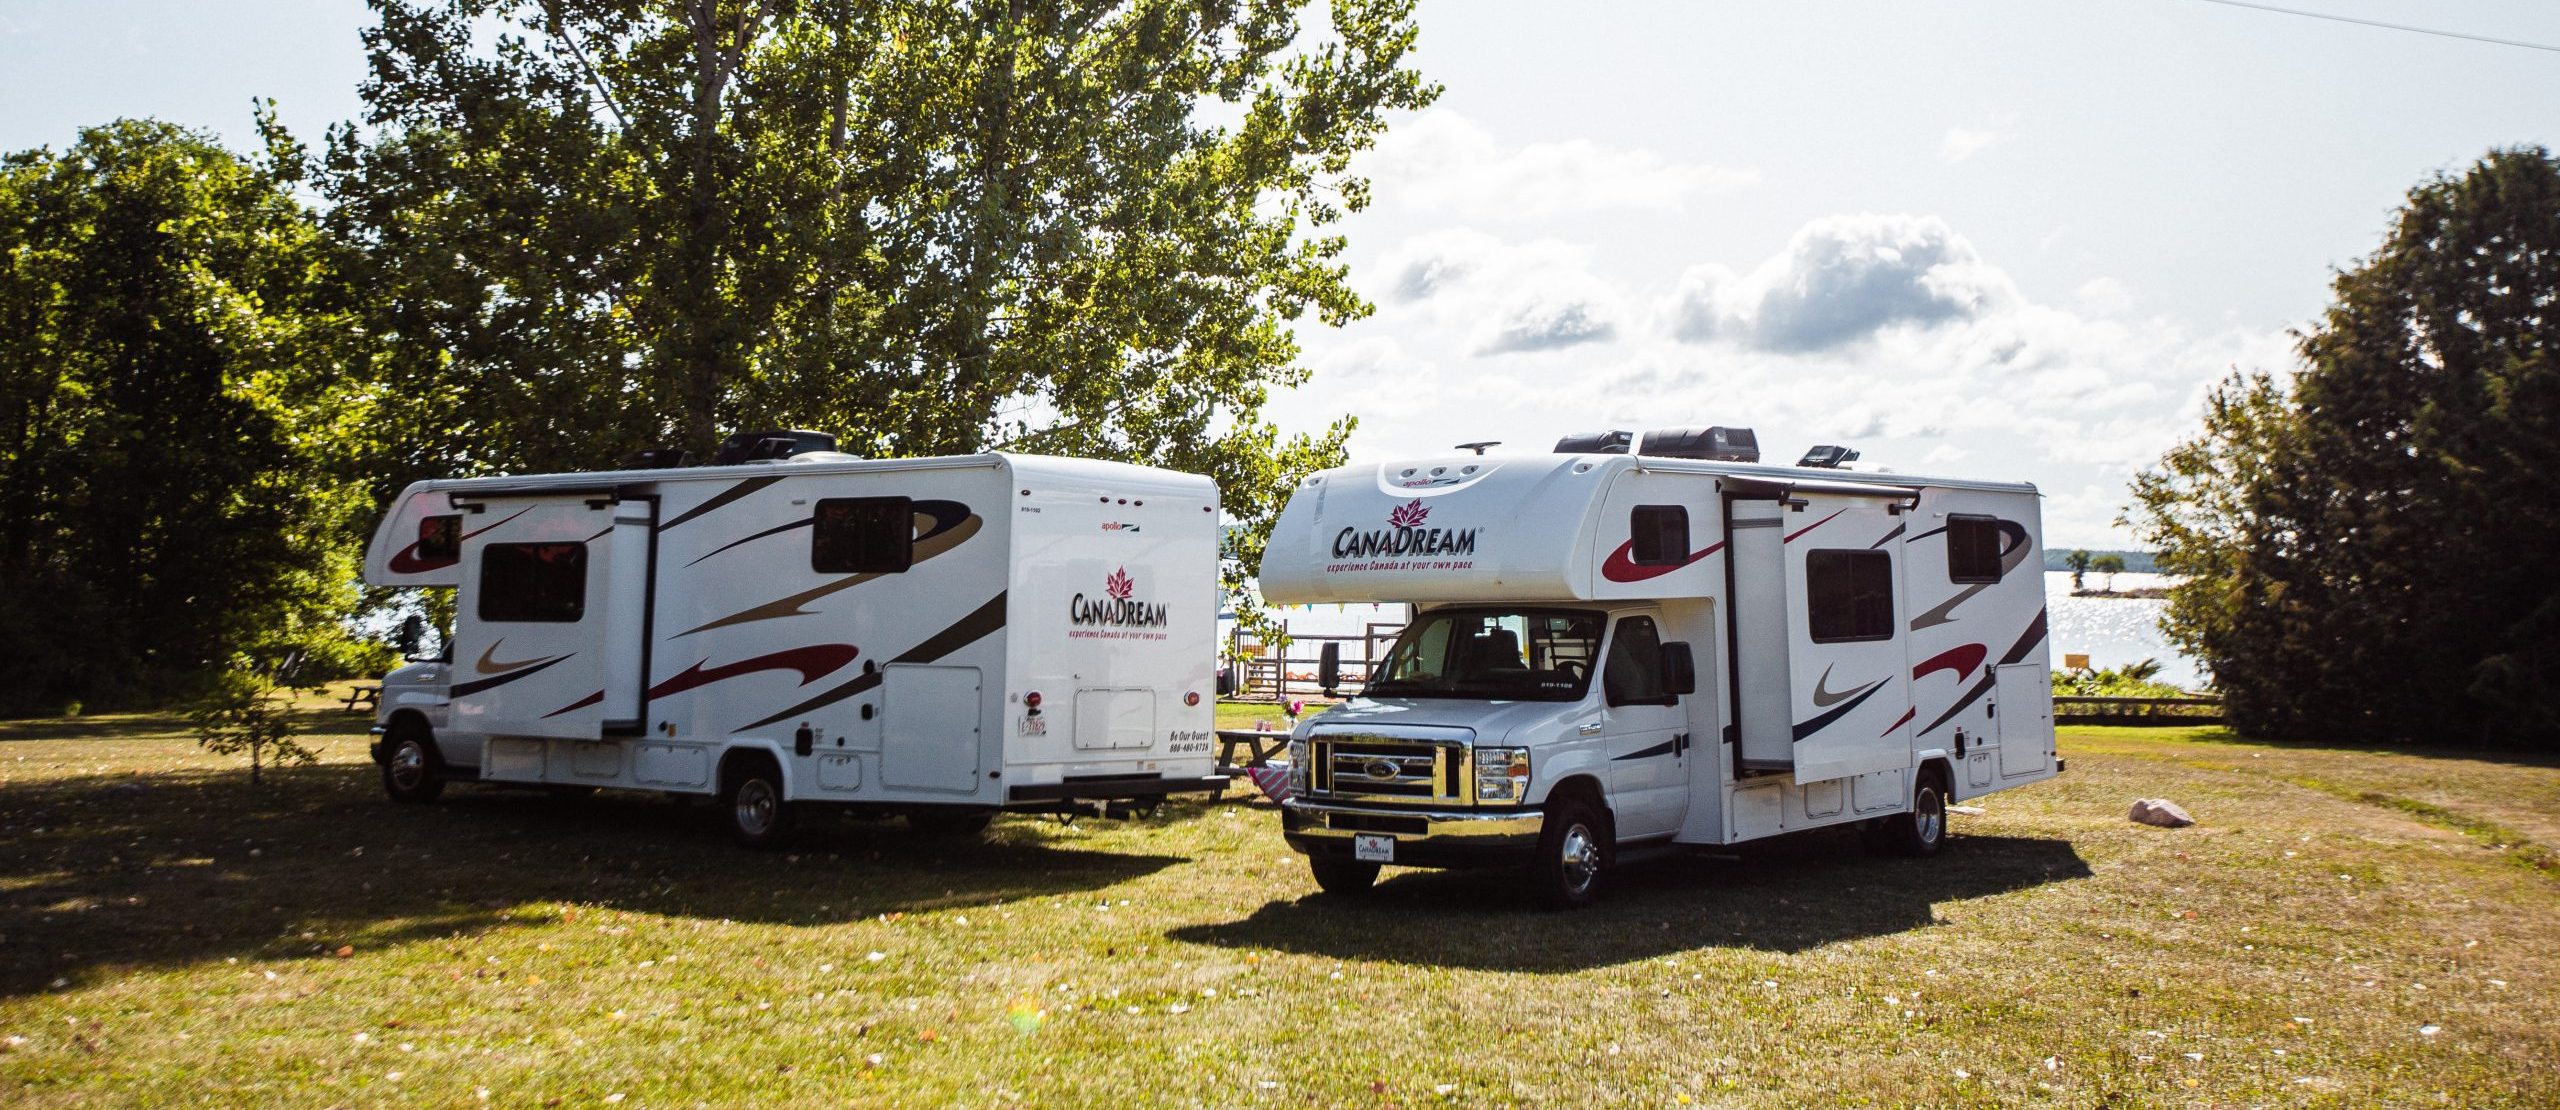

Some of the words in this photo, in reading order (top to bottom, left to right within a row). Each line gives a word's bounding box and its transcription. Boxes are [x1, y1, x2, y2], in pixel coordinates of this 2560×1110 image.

[1402, 478, 1431, 488] apollo
[1101, 521, 1122, 532] apollo
[1327, 562, 1368, 574] experience
[1369, 560, 1399, 571] Canada
[1400, 560, 1410, 570] at
[1412, 561, 1431, 571] your
[1433, 561, 1450, 569] own
[1453, 561, 1473, 572] pace
[1069, 629, 1099, 640] experience
[1100, 629, 1121, 639] Canada
[1121, 630, 1128, 639] at
[1129, 631, 1141, 641] your
[1155, 633, 1167, 641] pace
[1170, 730, 1178, 741] Be
[1179, 730, 1191, 741] Our
[1192, 730, 1209, 741] Guest
